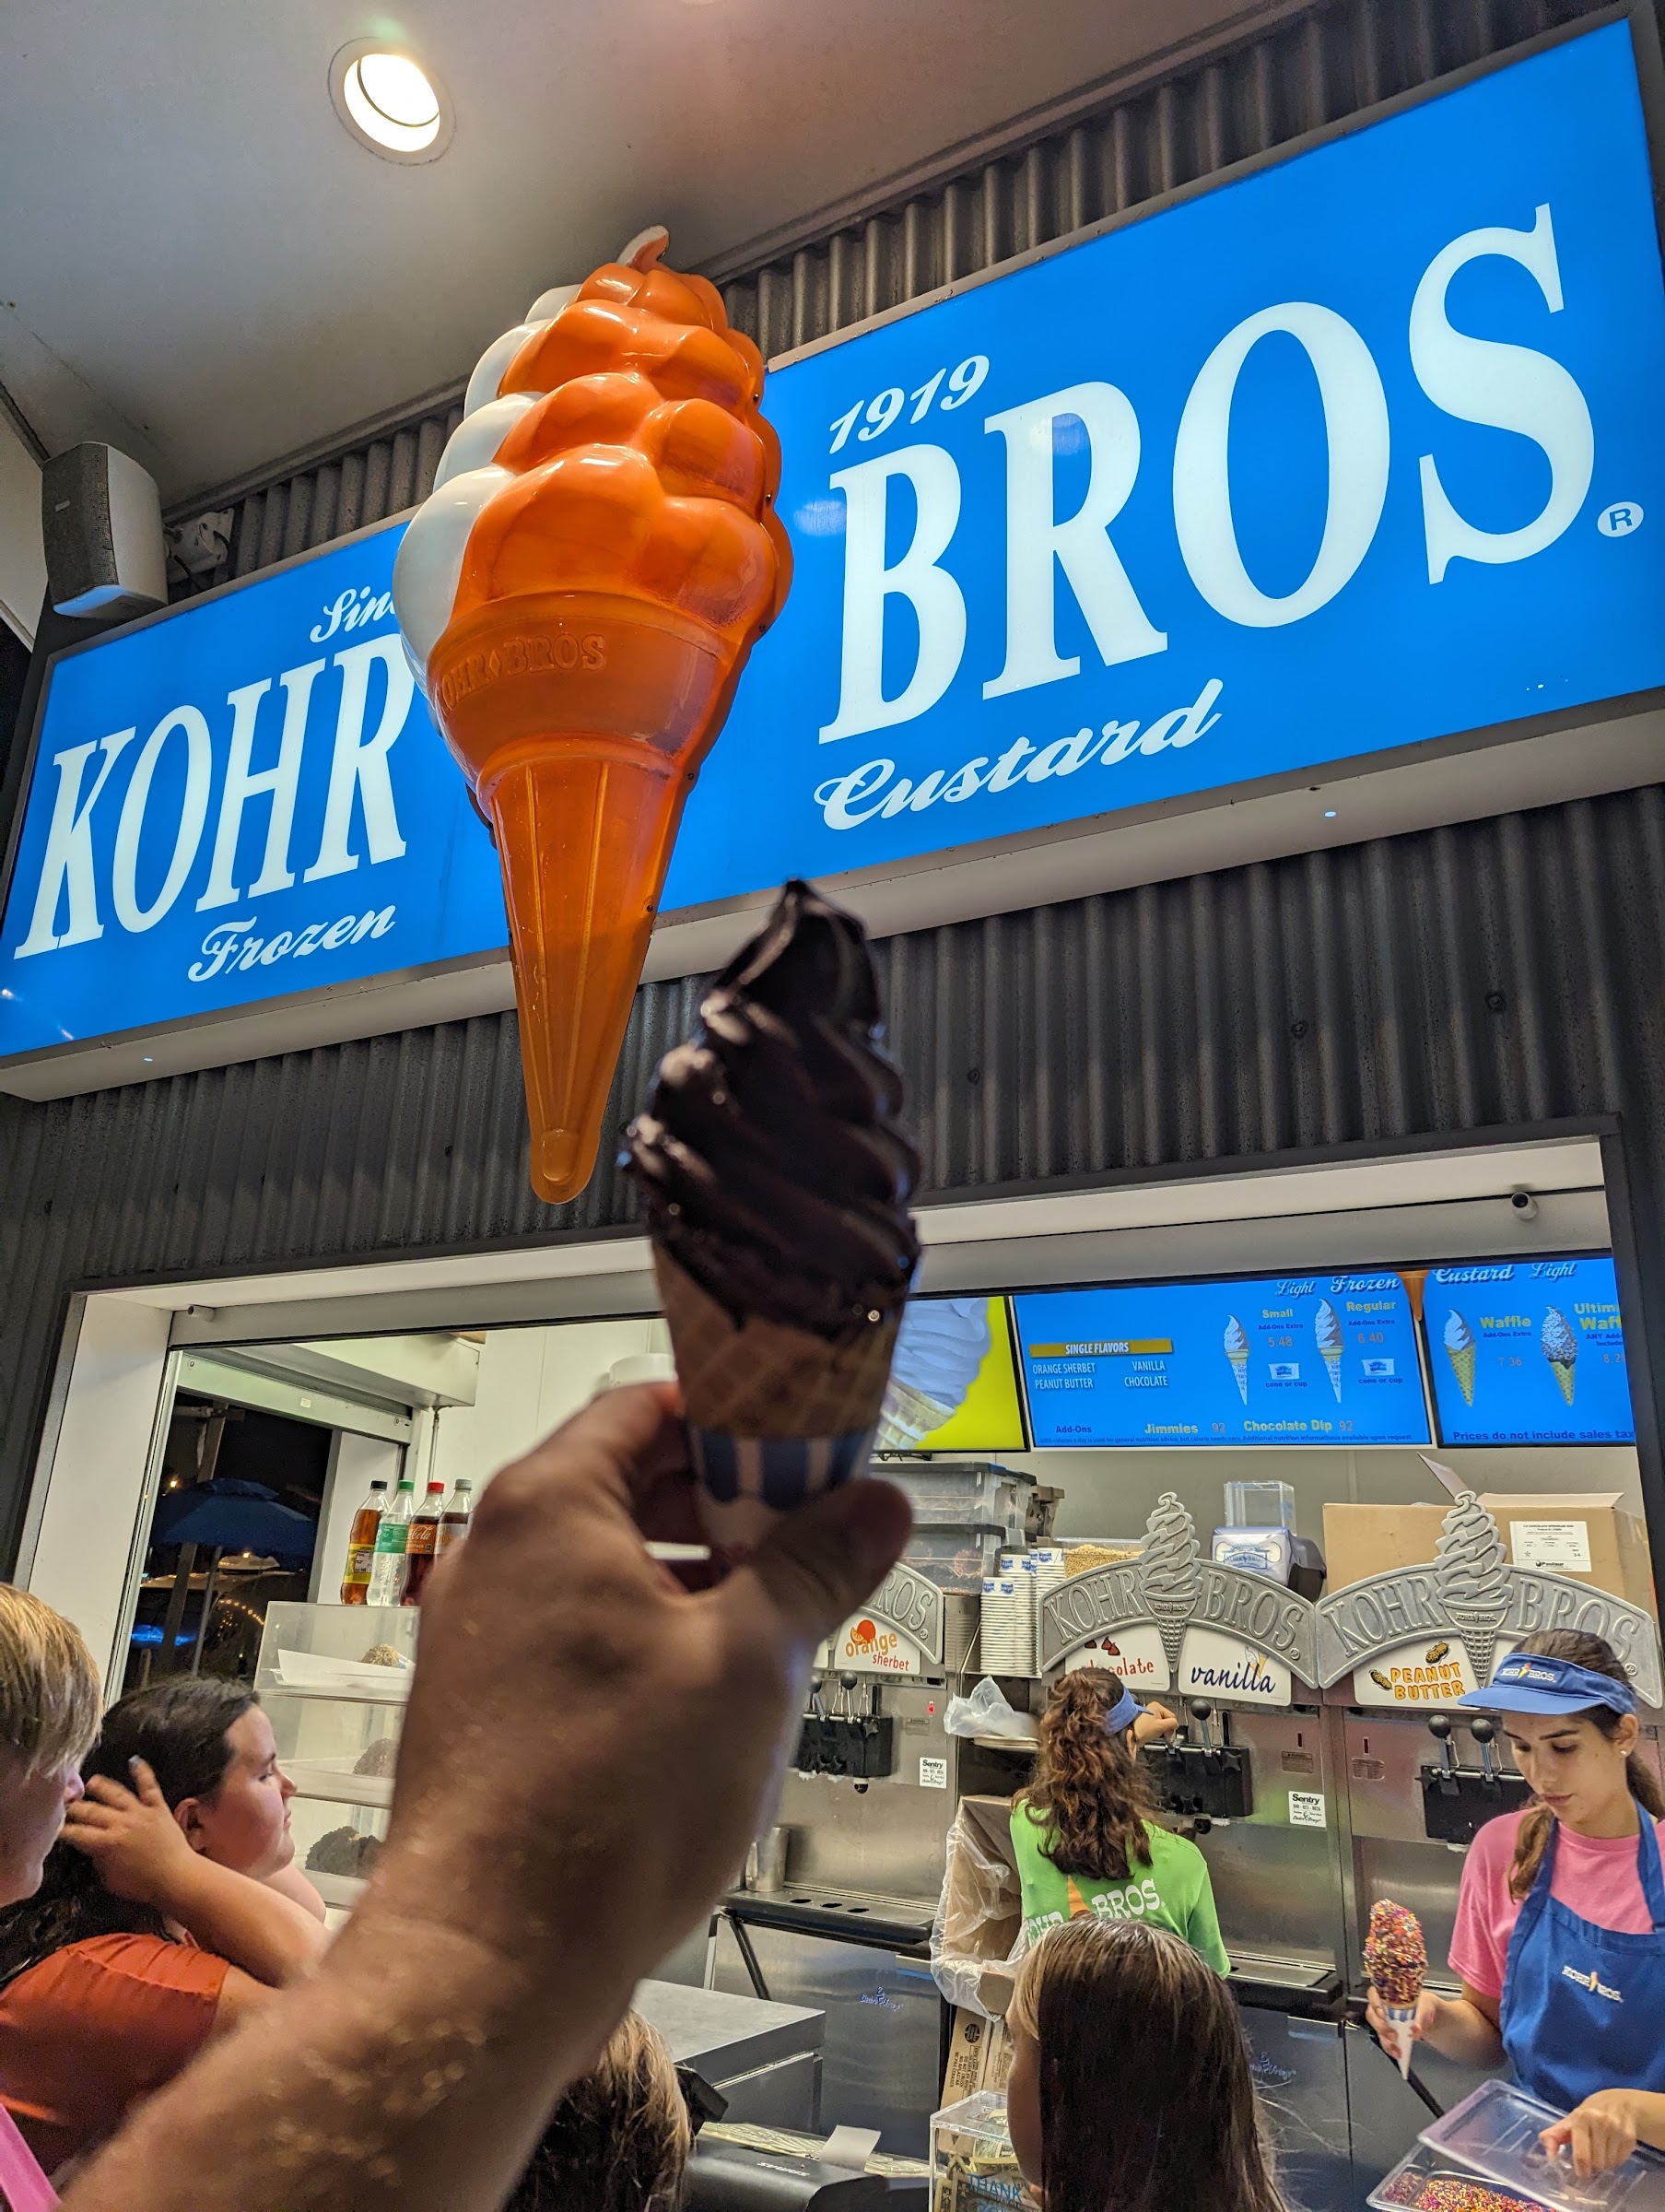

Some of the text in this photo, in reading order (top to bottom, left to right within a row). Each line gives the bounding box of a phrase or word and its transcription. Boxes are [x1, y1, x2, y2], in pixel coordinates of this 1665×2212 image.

[310, 355, 990, 643] Sin 1919
[14, 203, 1596, 959] KOHR BROS
[440, 633, 607, 712] OHR BROS
[188, 678, 1224, 982] Frozen Custard
[1432, 1262, 1577, 1284] Custard Light
[1275, 1276, 1401, 1299] Light Frozen
[1262, 1309, 1294, 1319] Small
[1346, 1300, 1397, 1313] Regular
[1574, 1302, 1621, 1314] Ultim
[1480, 1316, 1532, 1328] Waffle
[1579, 1315, 1623, 1330] Waff
[1065, 1342, 1130, 1355] SINGLE FLAVORS
[1032, 1362, 1096, 1374] ORANGE SHERBET
[1131, 1359, 1166, 1371] VANILLA
[1035, 1378, 1094, 1389] PEANUT BUTTER
[1124, 1376, 1167, 1387] CHOCOLATE
[1056, 1424, 1092, 1433] Add-Ons
[1144, 1422, 1199, 1434] Jimmies
[1243, 1419, 1307, 1432] Chocolate
[1311, 1418, 1332, 1432] Dip
[1453, 1430, 1634, 1441] Prices do not include sales tax
[866, 1570, 933, 1631] ROS
[1043, 1568, 1144, 1645] KOHR
[1321, 1575, 1444, 1659] KOHR
[845, 1632, 897, 1657] orange
[872, 1652, 909, 1671] sherbet
[1090, 1657, 1155, 1677] colate
[1190, 1661, 1276, 1694] vanilla
[1390, 1662, 1461, 1683] PEANUT
[1394, 1679, 1466, 1701] BUTTER
[922, 1759, 944, 1770] Sentry
[1292, 1794, 1320, 1806] Sentry
[967, 2173, 1022, 2203] THANK
